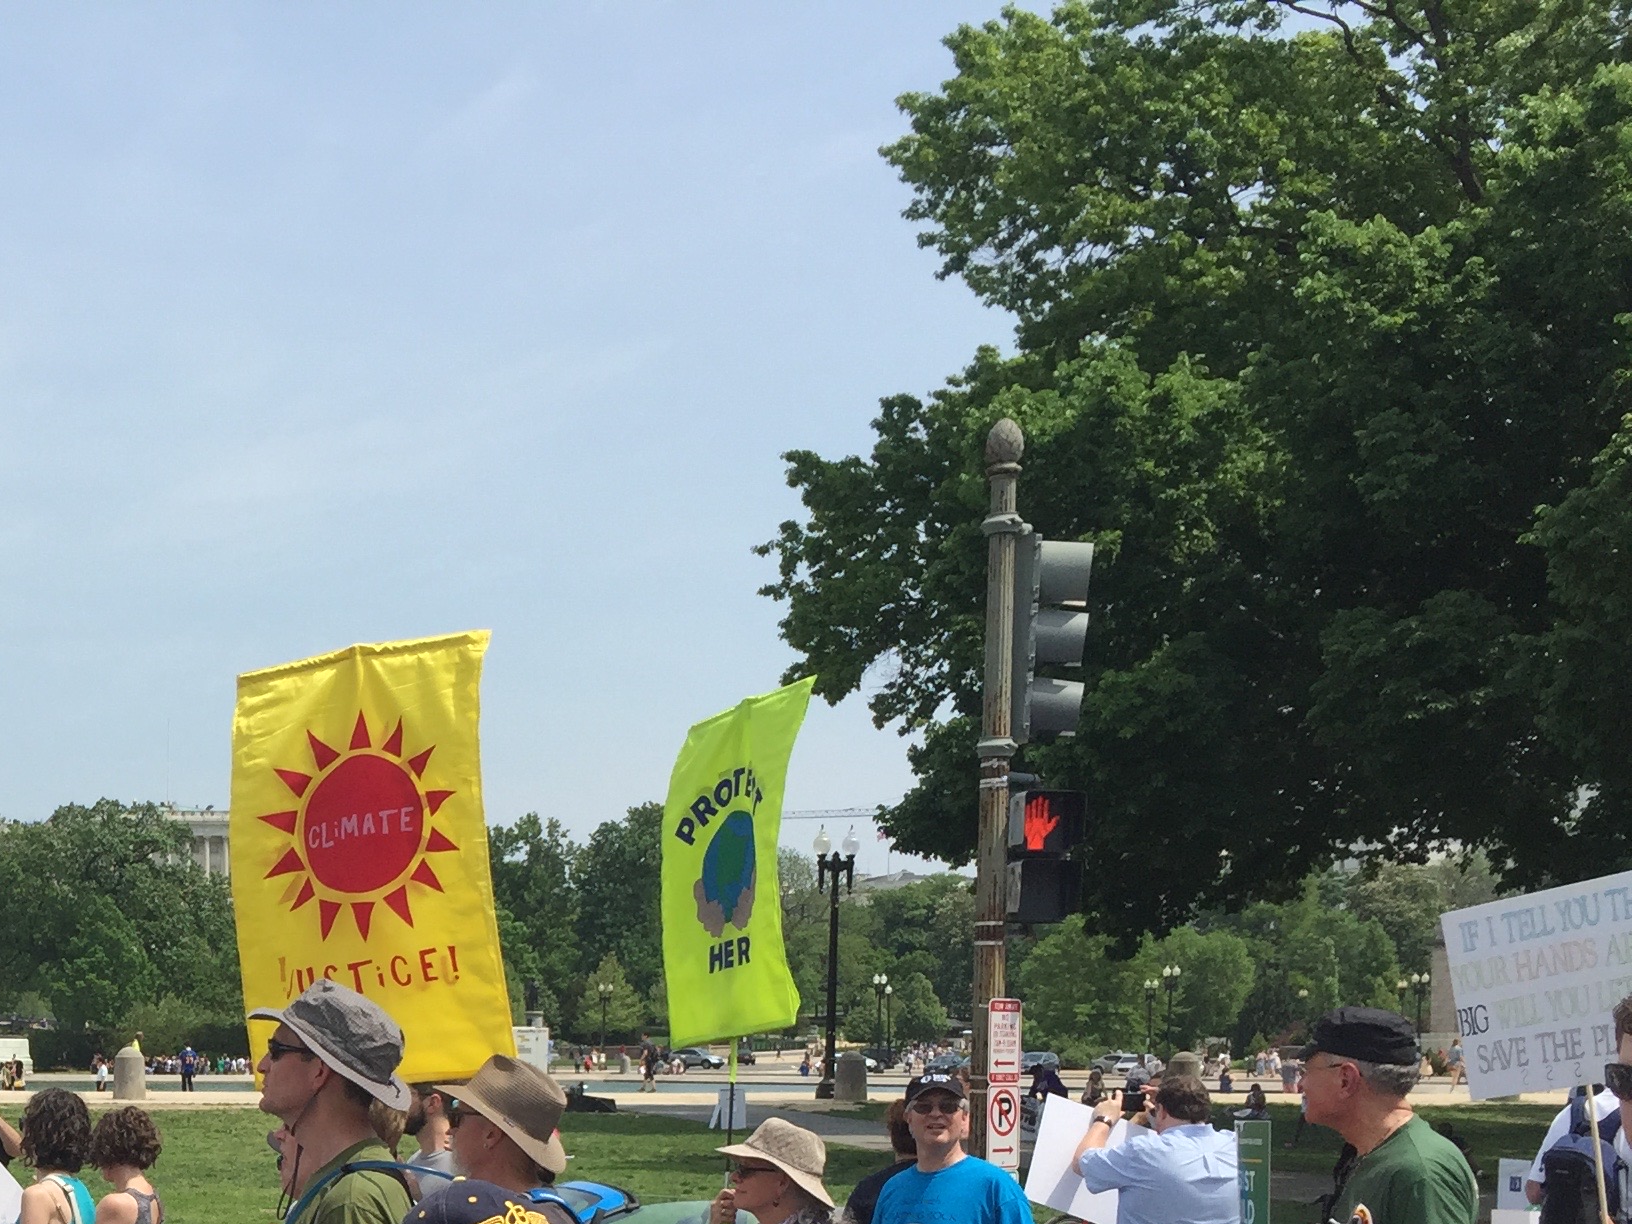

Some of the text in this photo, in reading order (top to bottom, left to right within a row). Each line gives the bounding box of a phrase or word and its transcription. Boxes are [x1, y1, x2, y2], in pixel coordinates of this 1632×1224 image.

[1458, 920, 1480, 953] IF
[1485, 916, 1498, 948] I
[1501, 904, 1556, 944] TELL
[1554, 892, 1601, 933] YOU
[708, 935, 751, 974] HER
[1451, 955, 1512, 996] YOUR
[1513, 938, 1599, 983] HANDS
[1457, 1004, 1490, 1038] BIG
[1477, 1036, 1530, 1076] SAVE
[1535, 1027, 1586, 1064] THE
